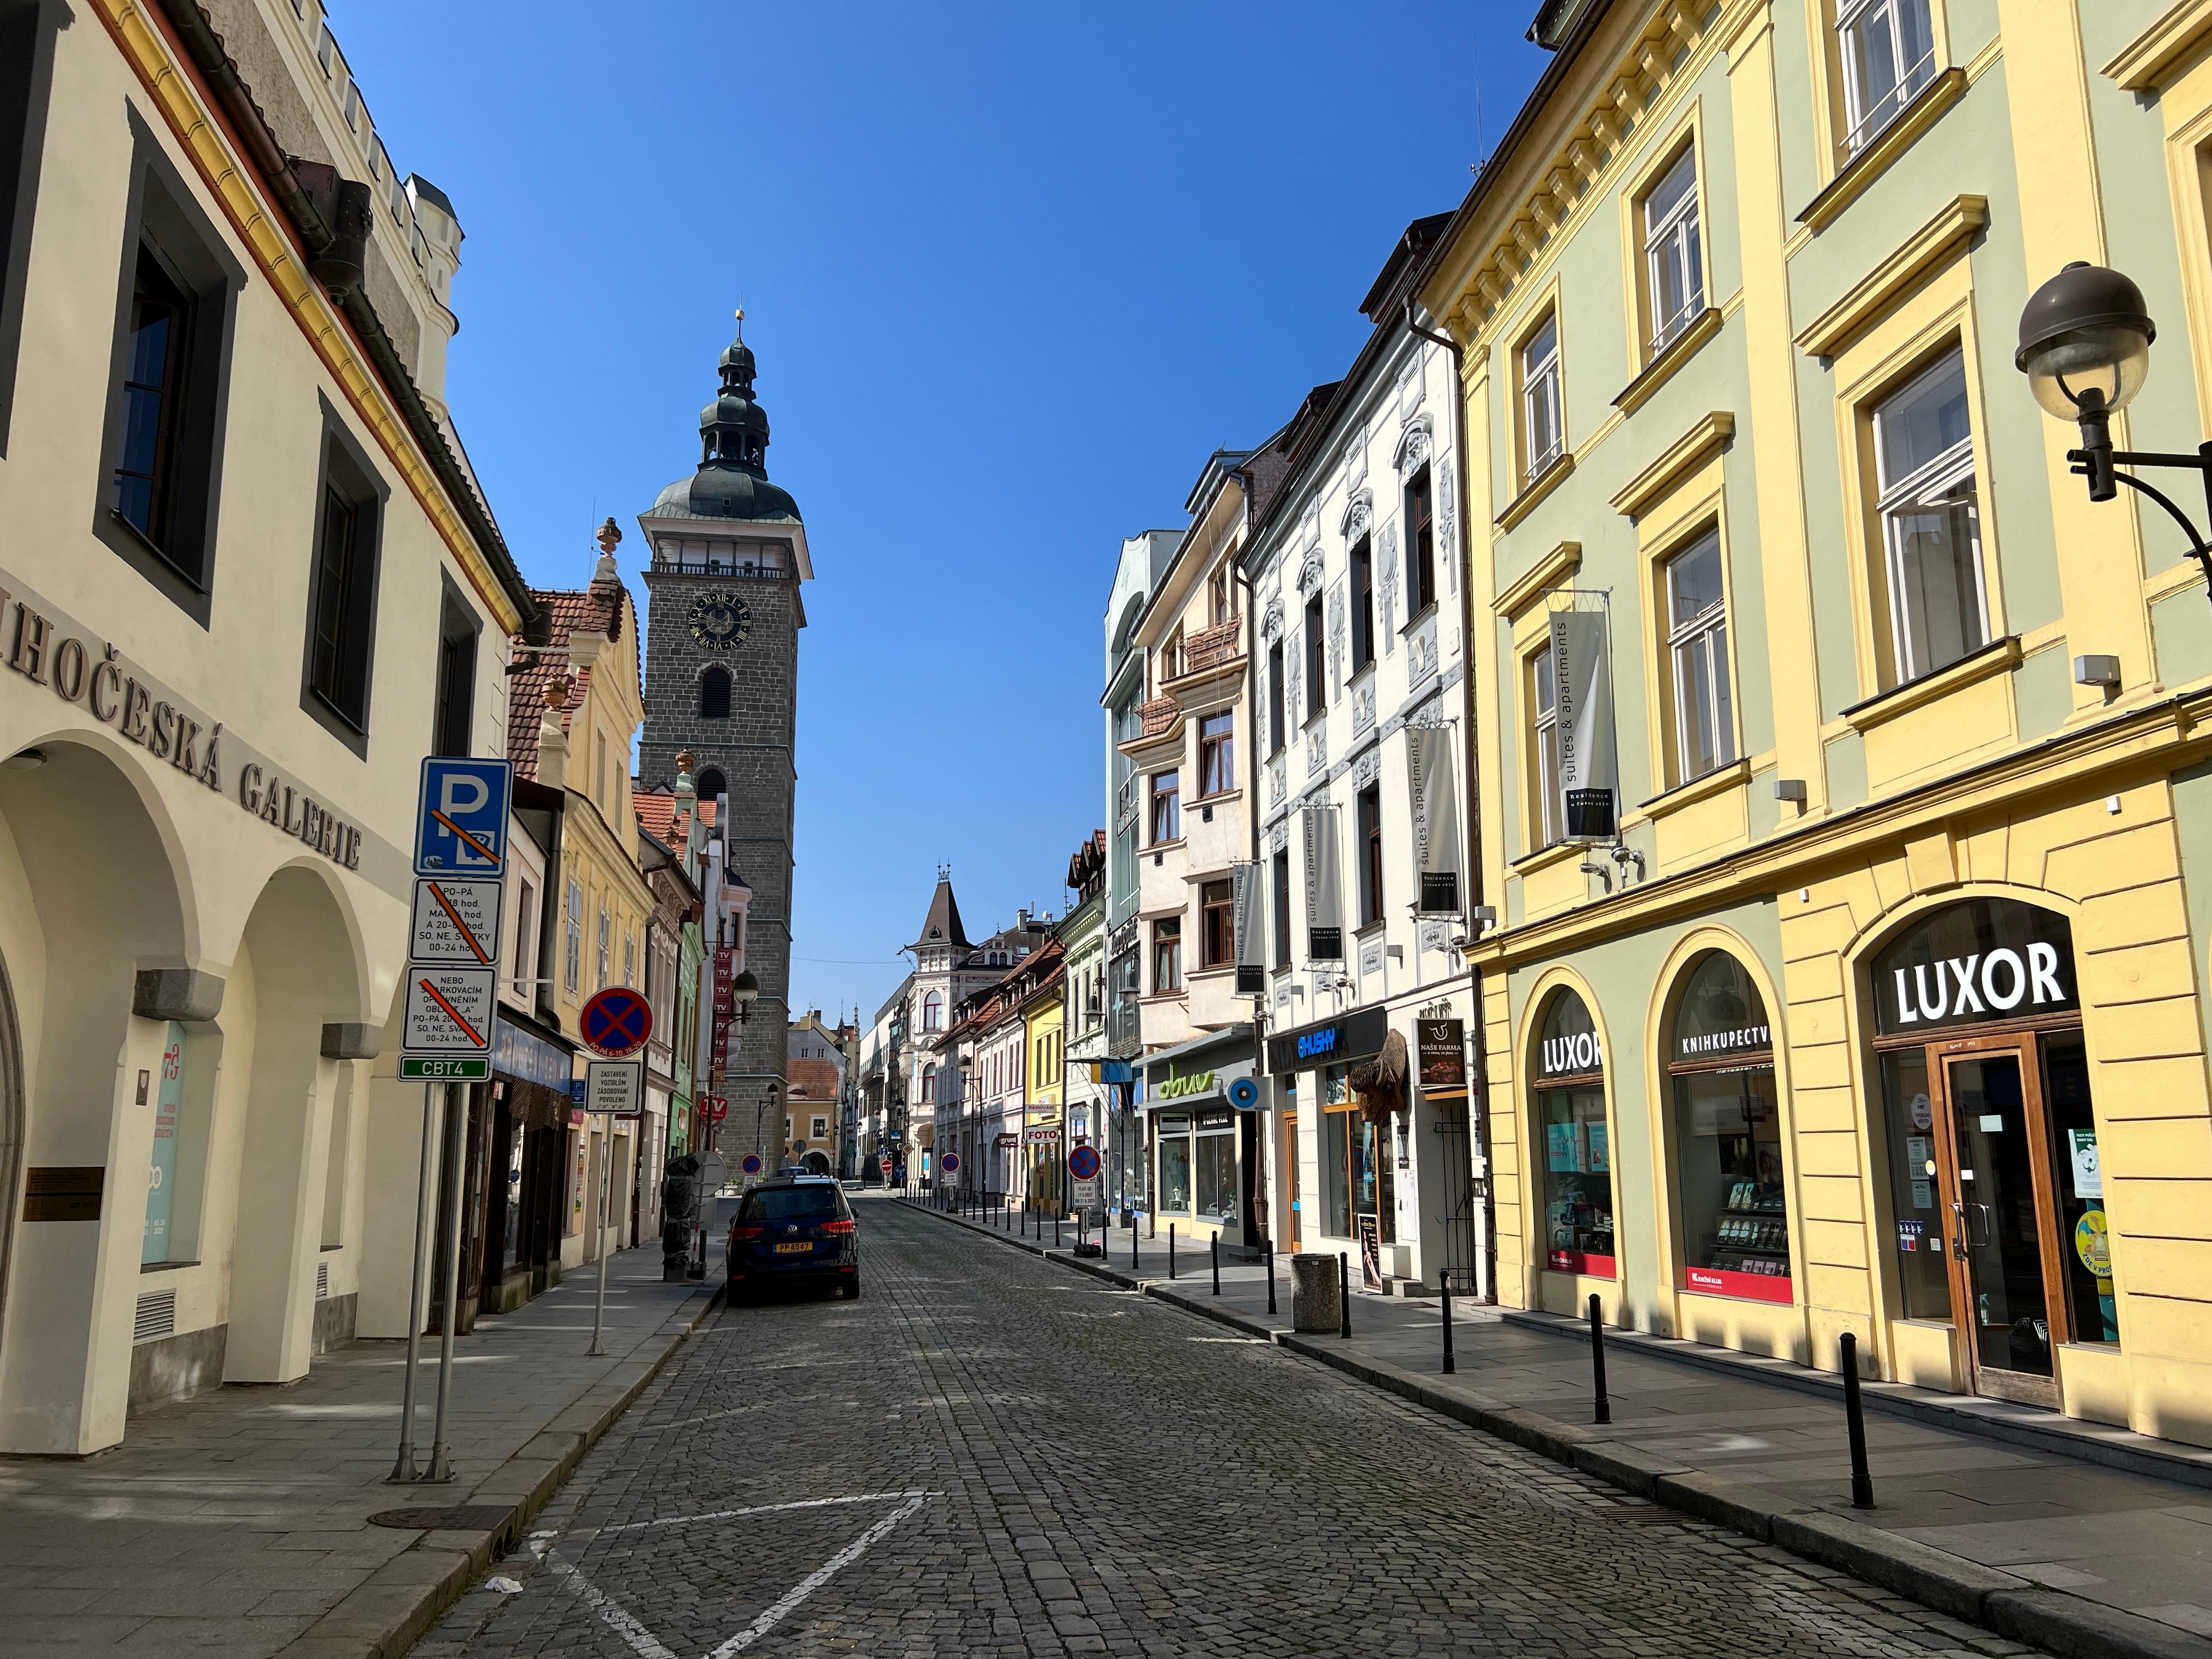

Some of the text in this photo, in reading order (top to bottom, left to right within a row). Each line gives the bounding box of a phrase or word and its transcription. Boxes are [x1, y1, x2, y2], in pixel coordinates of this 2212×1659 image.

[1556, 623, 1576, 782] suites & apartments
[1411, 737, 1425, 810] apartments
[242, 763, 363, 870] GALERIE
[438, 774, 489, 837] P
[1306, 816, 1316, 876] apartments
[1419, 827, 1429, 865] suites
[443, 887, 473, 896] PO-PÁ
[461, 899, 480, 907] hod.
[1236, 870, 1244, 921] apartments
[465, 911, 483, 919] hod.
[430, 943, 456, 951] 00-24
[1894, 942, 2067, 1024] LUXOR
[413, 1014, 440, 1022] PO-PÁ
[589, 1042, 608, 1055] PO-PÁ
[625, 1041, 642, 1054] 18-20
[1544, 1031, 1602, 1073] LUXOR
[1683, 1025, 1773, 1054] KNIHKUPECTV
[422, 1062, 464, 1075] CBT4
[1159, 1058, 1215, 1100] obuv
[1001, 1137, 1017, 1145] grunt
[1029, 1131, 1057, 1139] FOTO
[2083, 1252, 2093, 1267] ZDE
